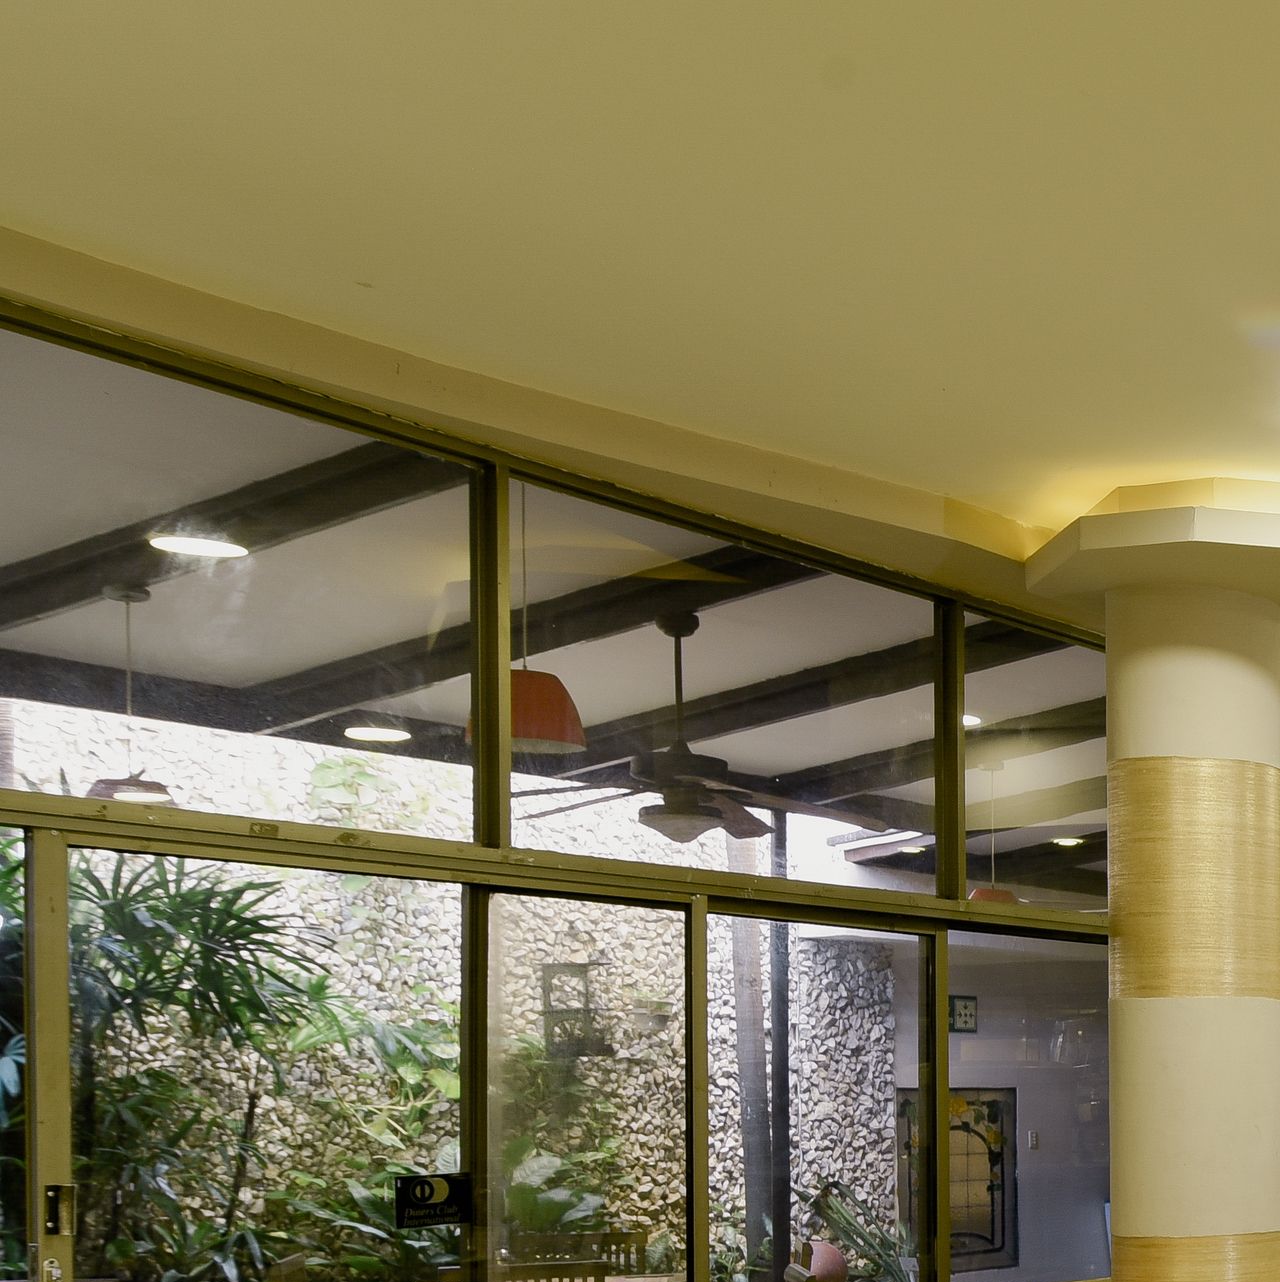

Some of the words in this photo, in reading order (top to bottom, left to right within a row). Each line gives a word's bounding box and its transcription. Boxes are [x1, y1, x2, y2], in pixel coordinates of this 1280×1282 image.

[405, 1208, 434, 1217] Diners
[436, 1205, 458, 1215] Club
[403, 1214, 460, 1226] International
